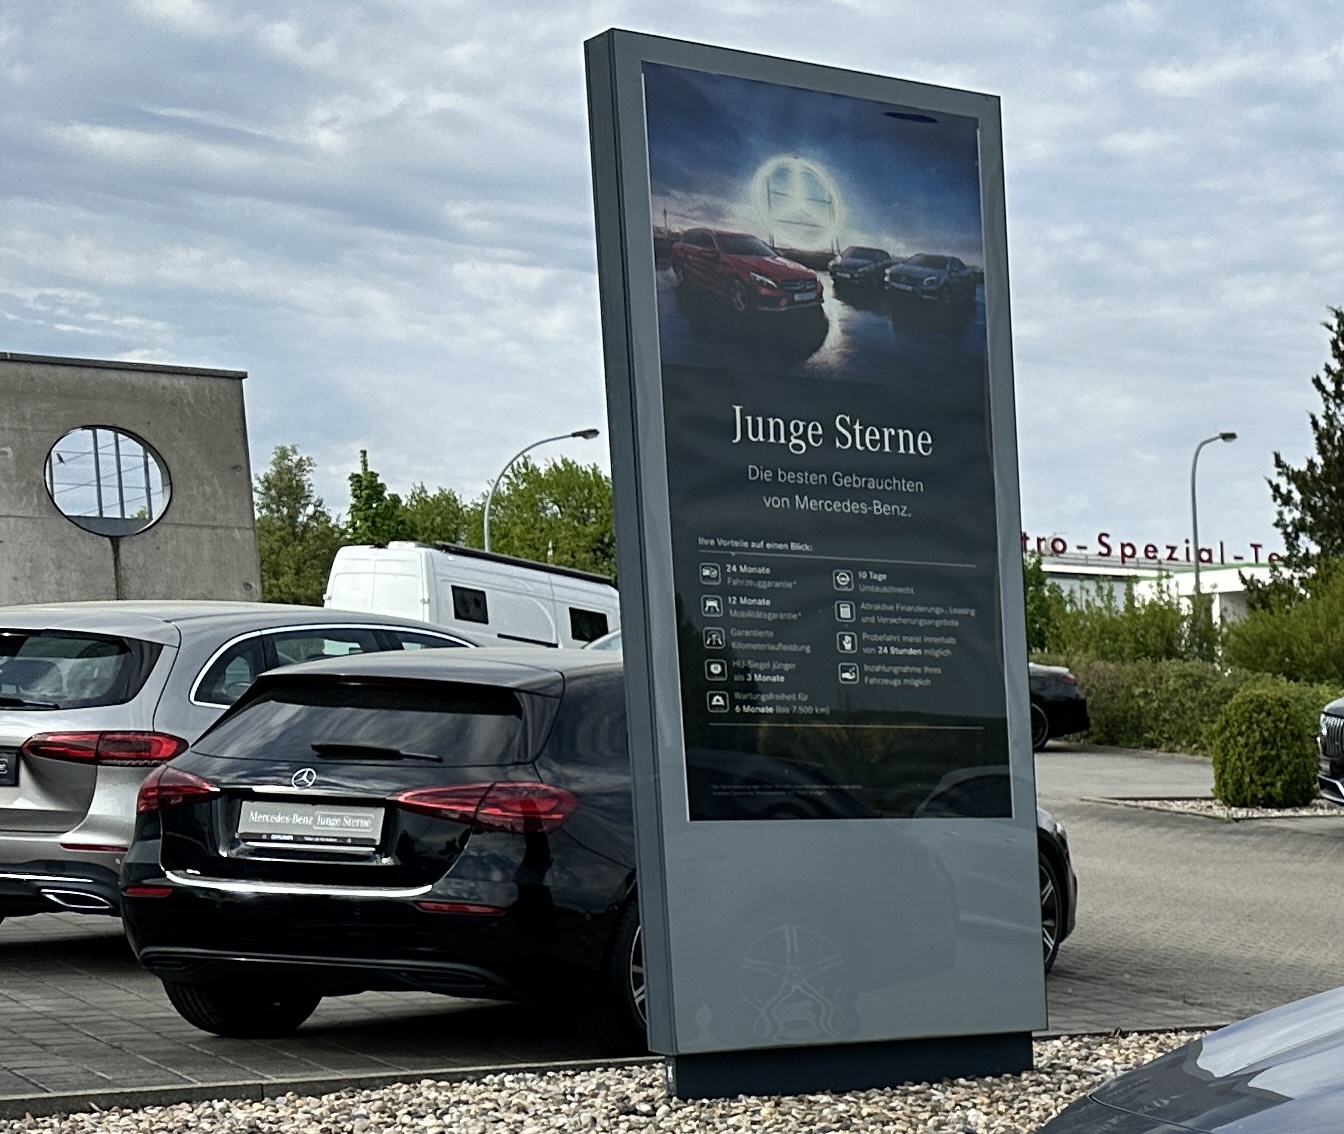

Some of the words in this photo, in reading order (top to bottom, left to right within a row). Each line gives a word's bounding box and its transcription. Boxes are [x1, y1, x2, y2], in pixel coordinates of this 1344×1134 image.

[731, 404, 823, 455] Junge
[835, 413, 933, 456] Sterne
[748, 464, 773, 482] Die
[777, 467, 828, 486] besten
[832, 471, 924, 493] Gebrauchten
[763, 495, 790, 509] von
[795, 494, 912, 517] Mercedes-Benz.
[698, 537, 715, 546] Ihre
[717, 538, 749, 549] Vorteile
[751, 540, 764, 549] auf
[765, 542, 789, 550] einen
[726, 564, 737, 573] 24
[739, 564, 771, 575] Monate
[869, 571, 888, 582] Tage
[728, 596, 737, 605] 12
[739, 596, 771, 607] Monate
[878, 646, 888, 655] 24
[746, 674, 752, 682] 3
[754, 674, 785, 683] Monate
[742, 704, 774, 714] Monate
[249, 810, 314, 826] Mercedes-Benz
[316, 814, 341, 828] Junge
[341, 815, 372, 829] Sterne
